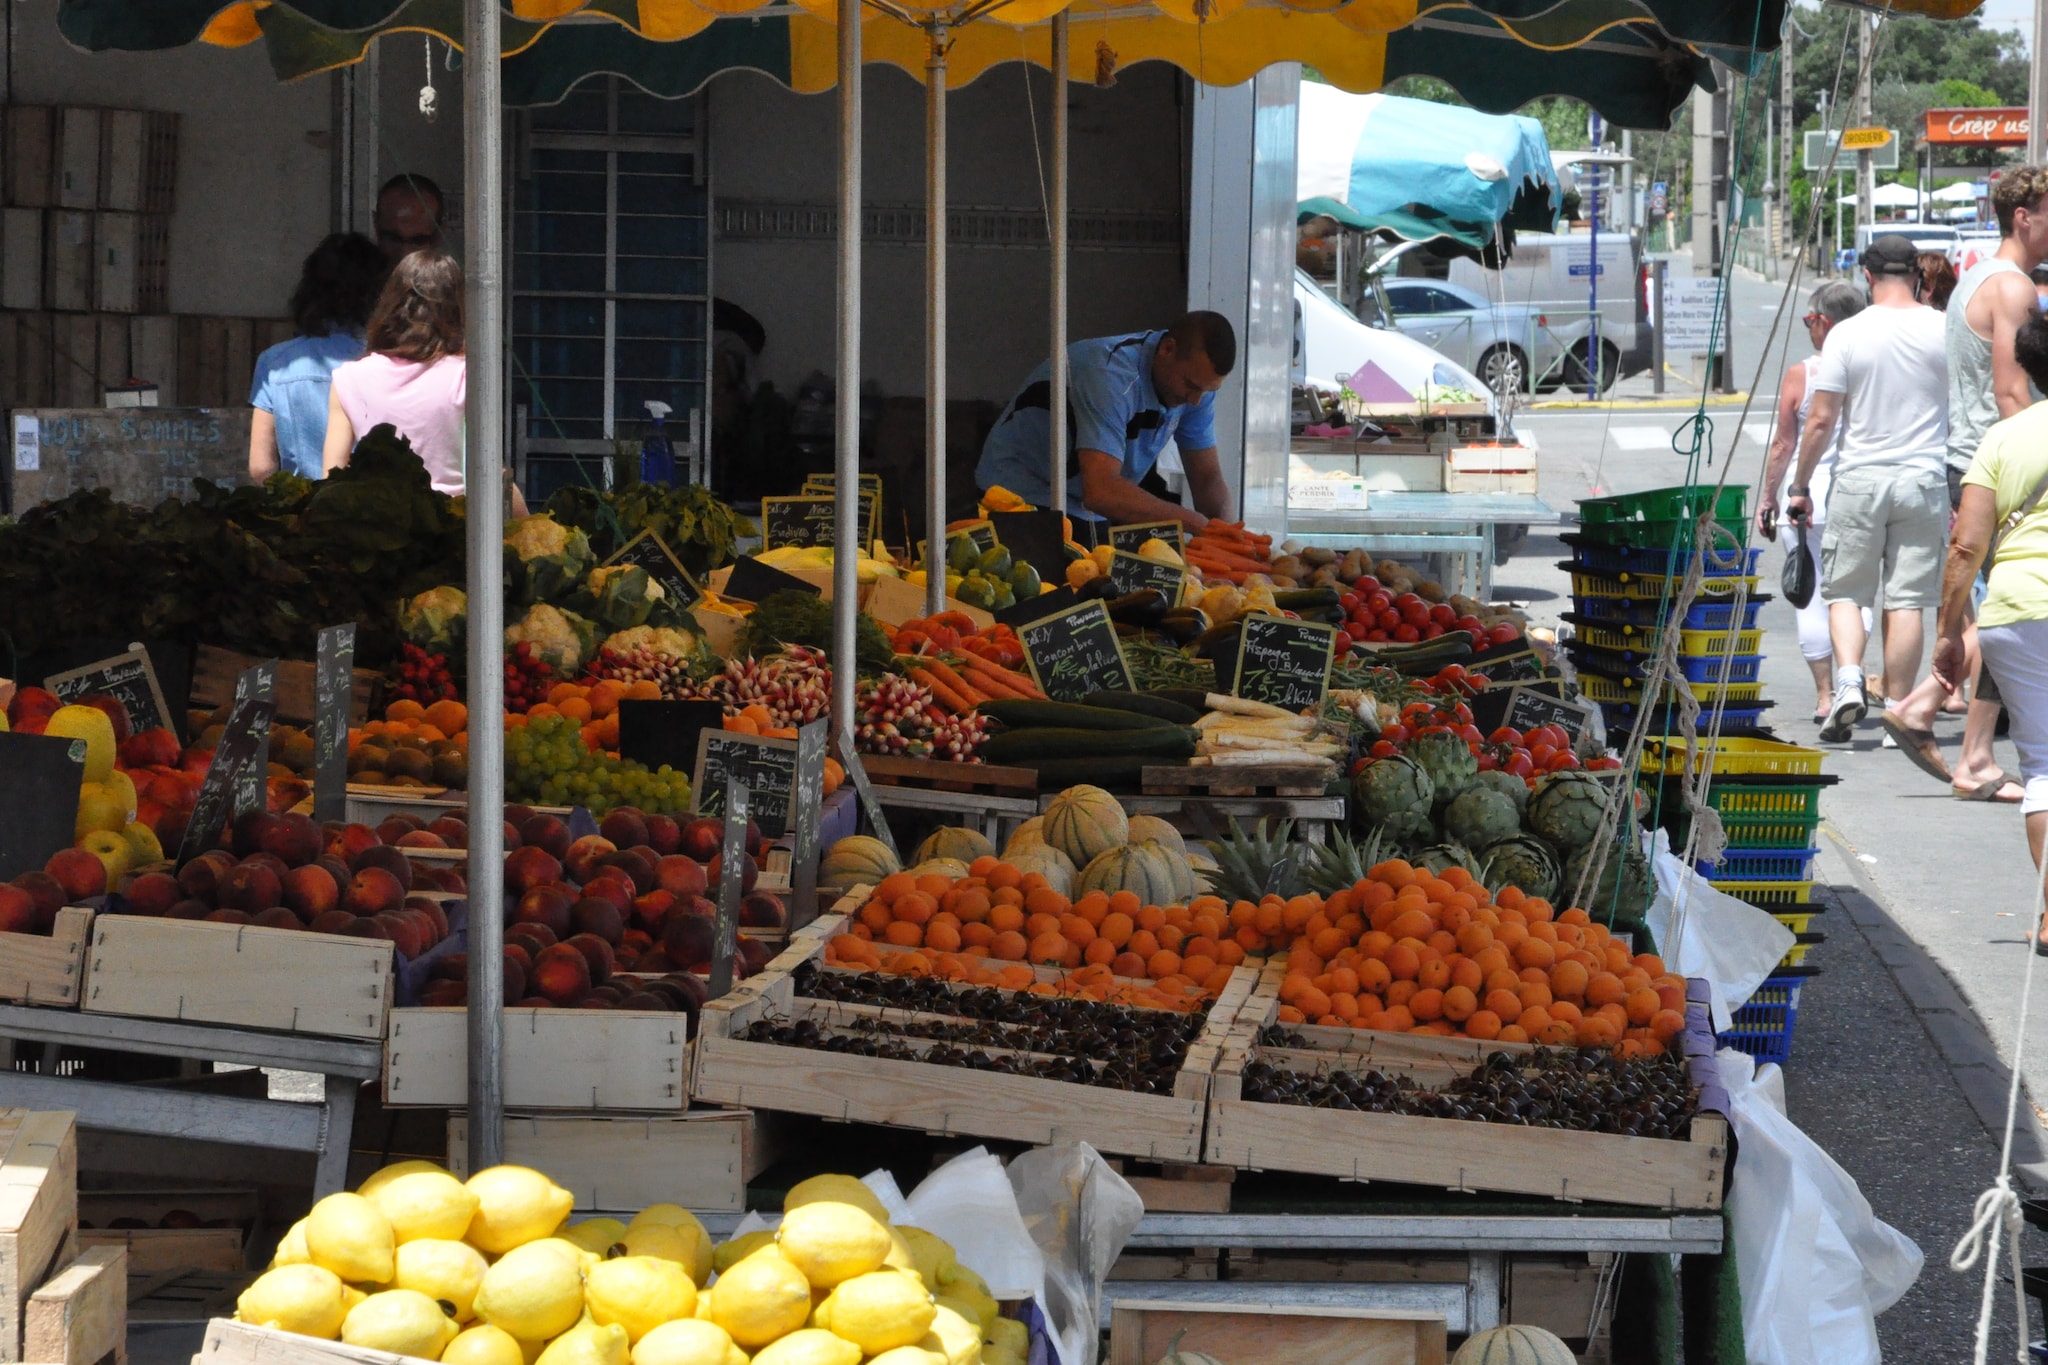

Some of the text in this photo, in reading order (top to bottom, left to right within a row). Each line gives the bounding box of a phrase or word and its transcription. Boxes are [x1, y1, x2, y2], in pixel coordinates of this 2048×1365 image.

[1844, 131, 1884, 145] DROGUERIE
[121, 416, 221, 443] SOMMES
[1036, 638, 1094, 665] Concombre
[1244, 637, 1291, 671] Asperges
